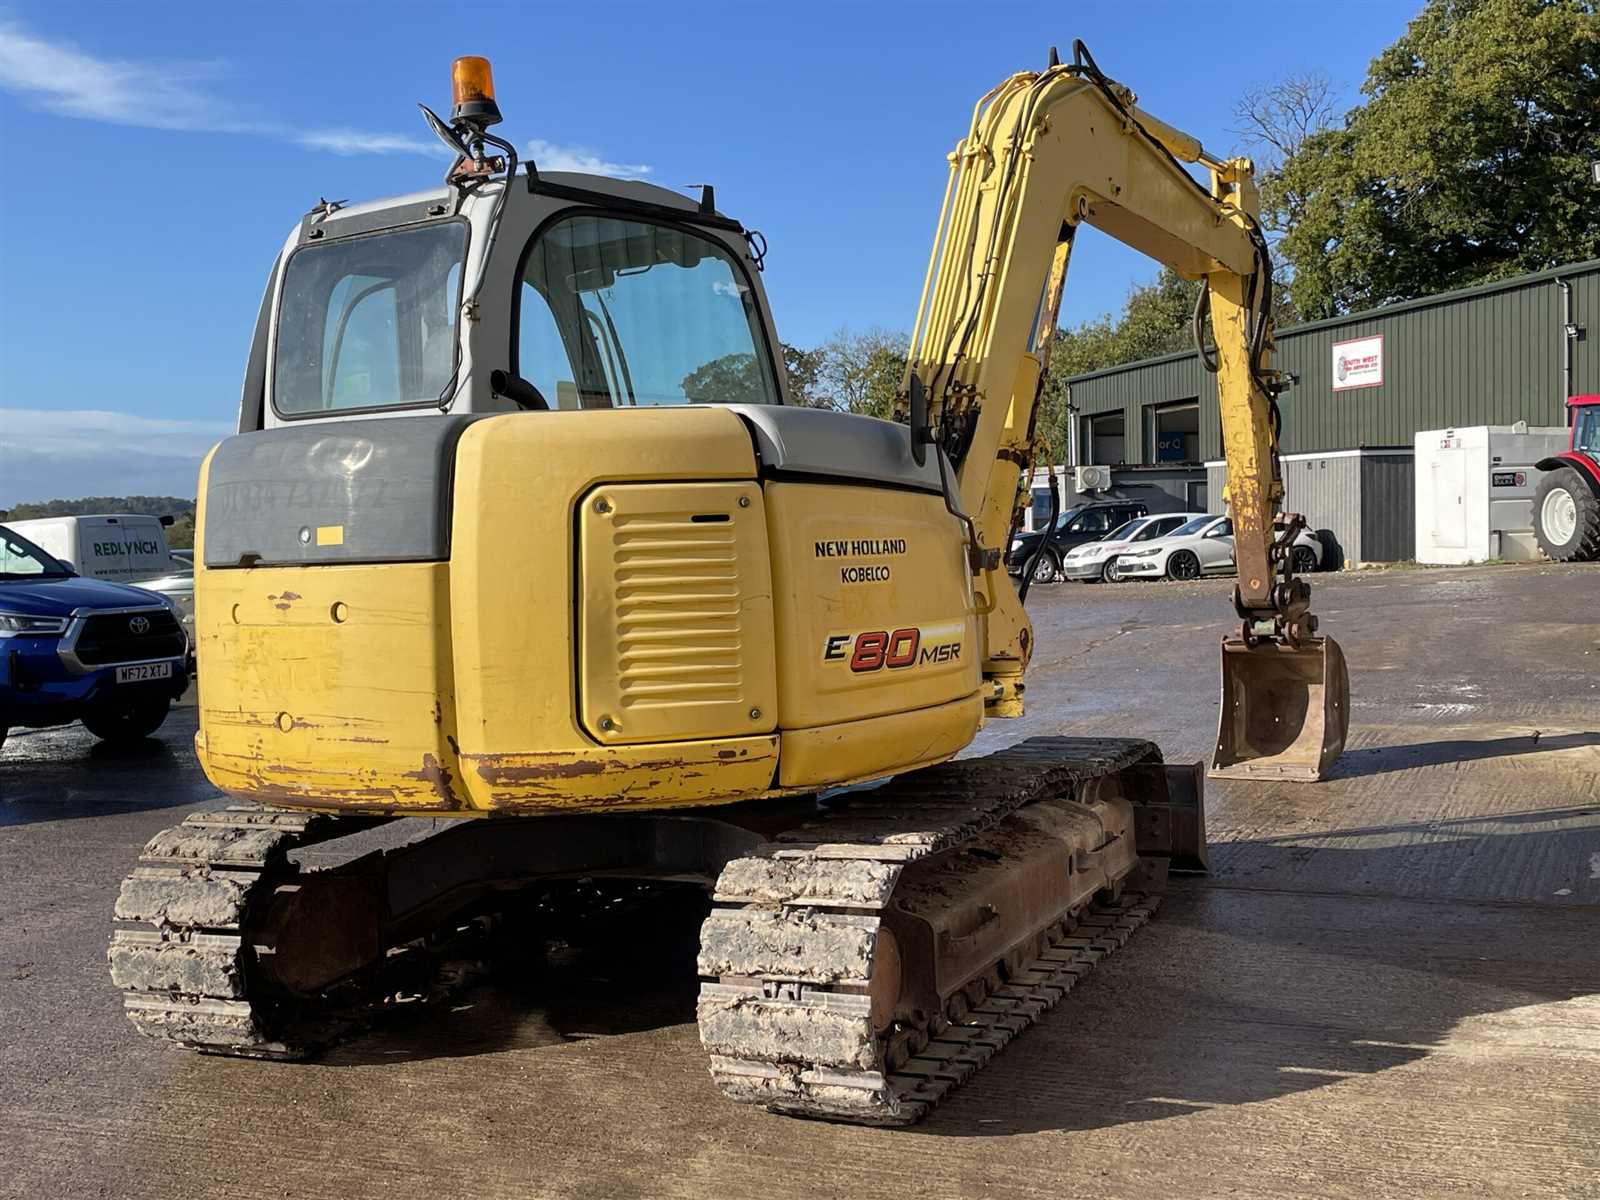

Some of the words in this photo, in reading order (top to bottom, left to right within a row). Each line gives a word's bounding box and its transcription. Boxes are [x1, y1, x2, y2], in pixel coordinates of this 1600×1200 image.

[93, 541, 158, 557] REDLYNCH
[815, 541, 848, 557] NEW
[852, 539, 906, 555] HOLLAND
[841, 566, 890, 583] KOBELCO
[121, 666, 147, 680] WF72
[150, 664, 168, 677] XTJ
